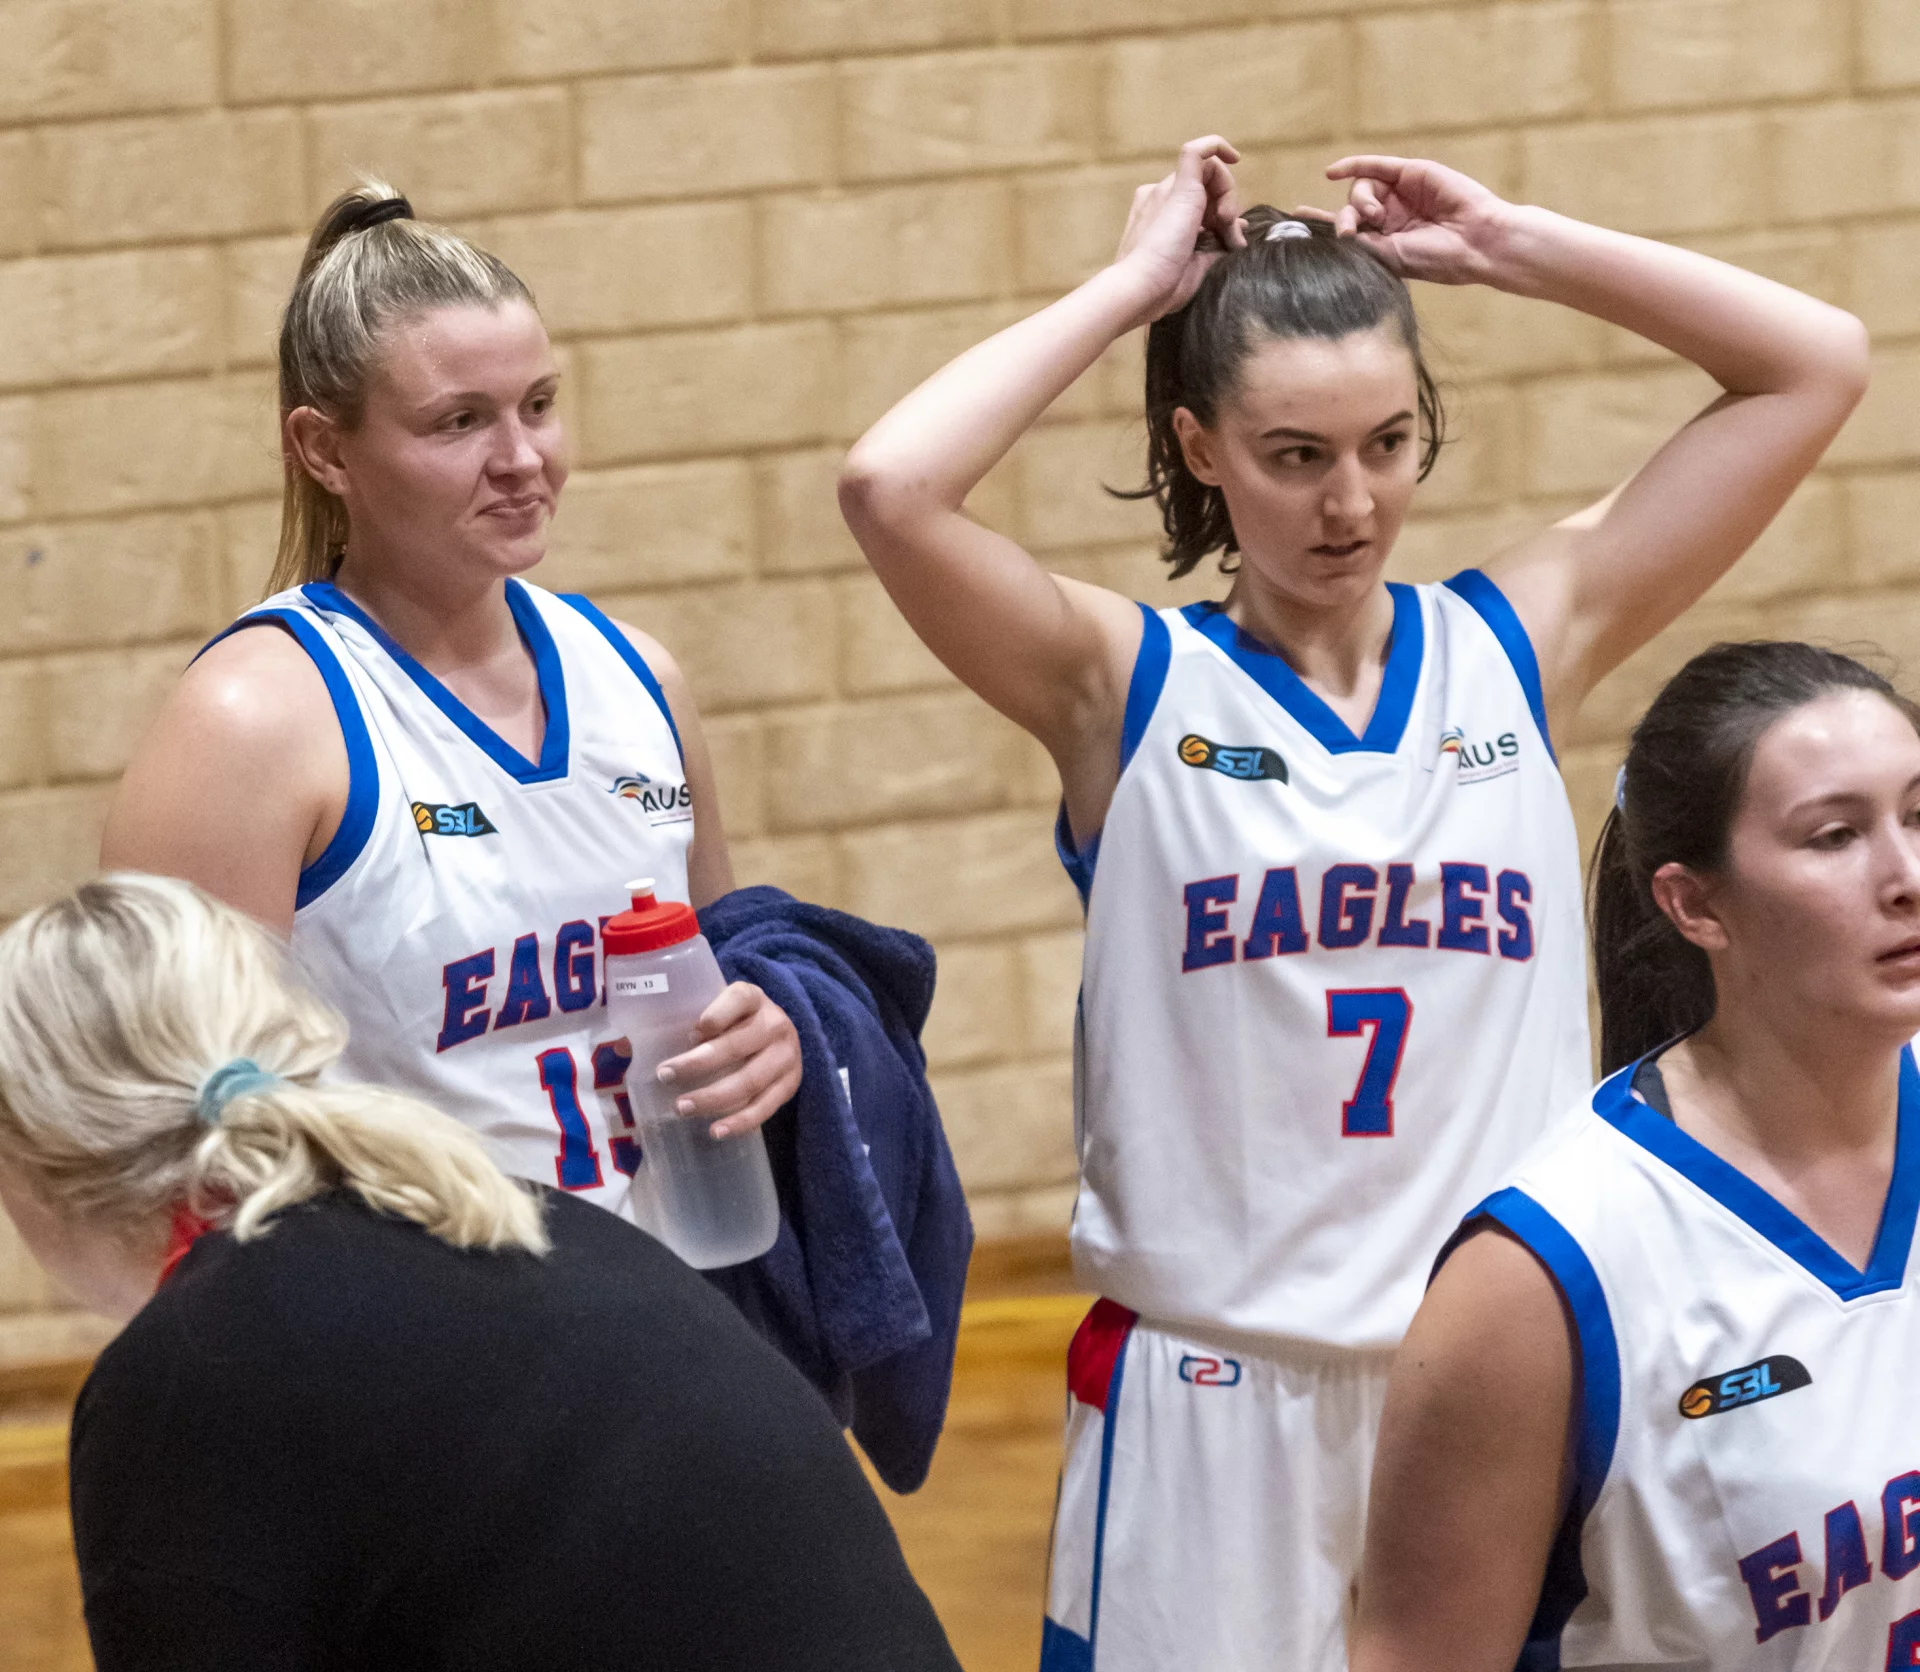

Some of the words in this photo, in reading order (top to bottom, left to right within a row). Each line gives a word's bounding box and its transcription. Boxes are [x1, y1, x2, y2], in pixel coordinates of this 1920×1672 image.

[1458, 732, 1519, 769] AUS
[642, 783, 692, 813] AUS
[1181, 862, 1535, 974] EAGLES
[436, 915, 608, 1054] EAG
[644, 980, 654, 989] 13
[1325, 986, 1415, 1138] 7
